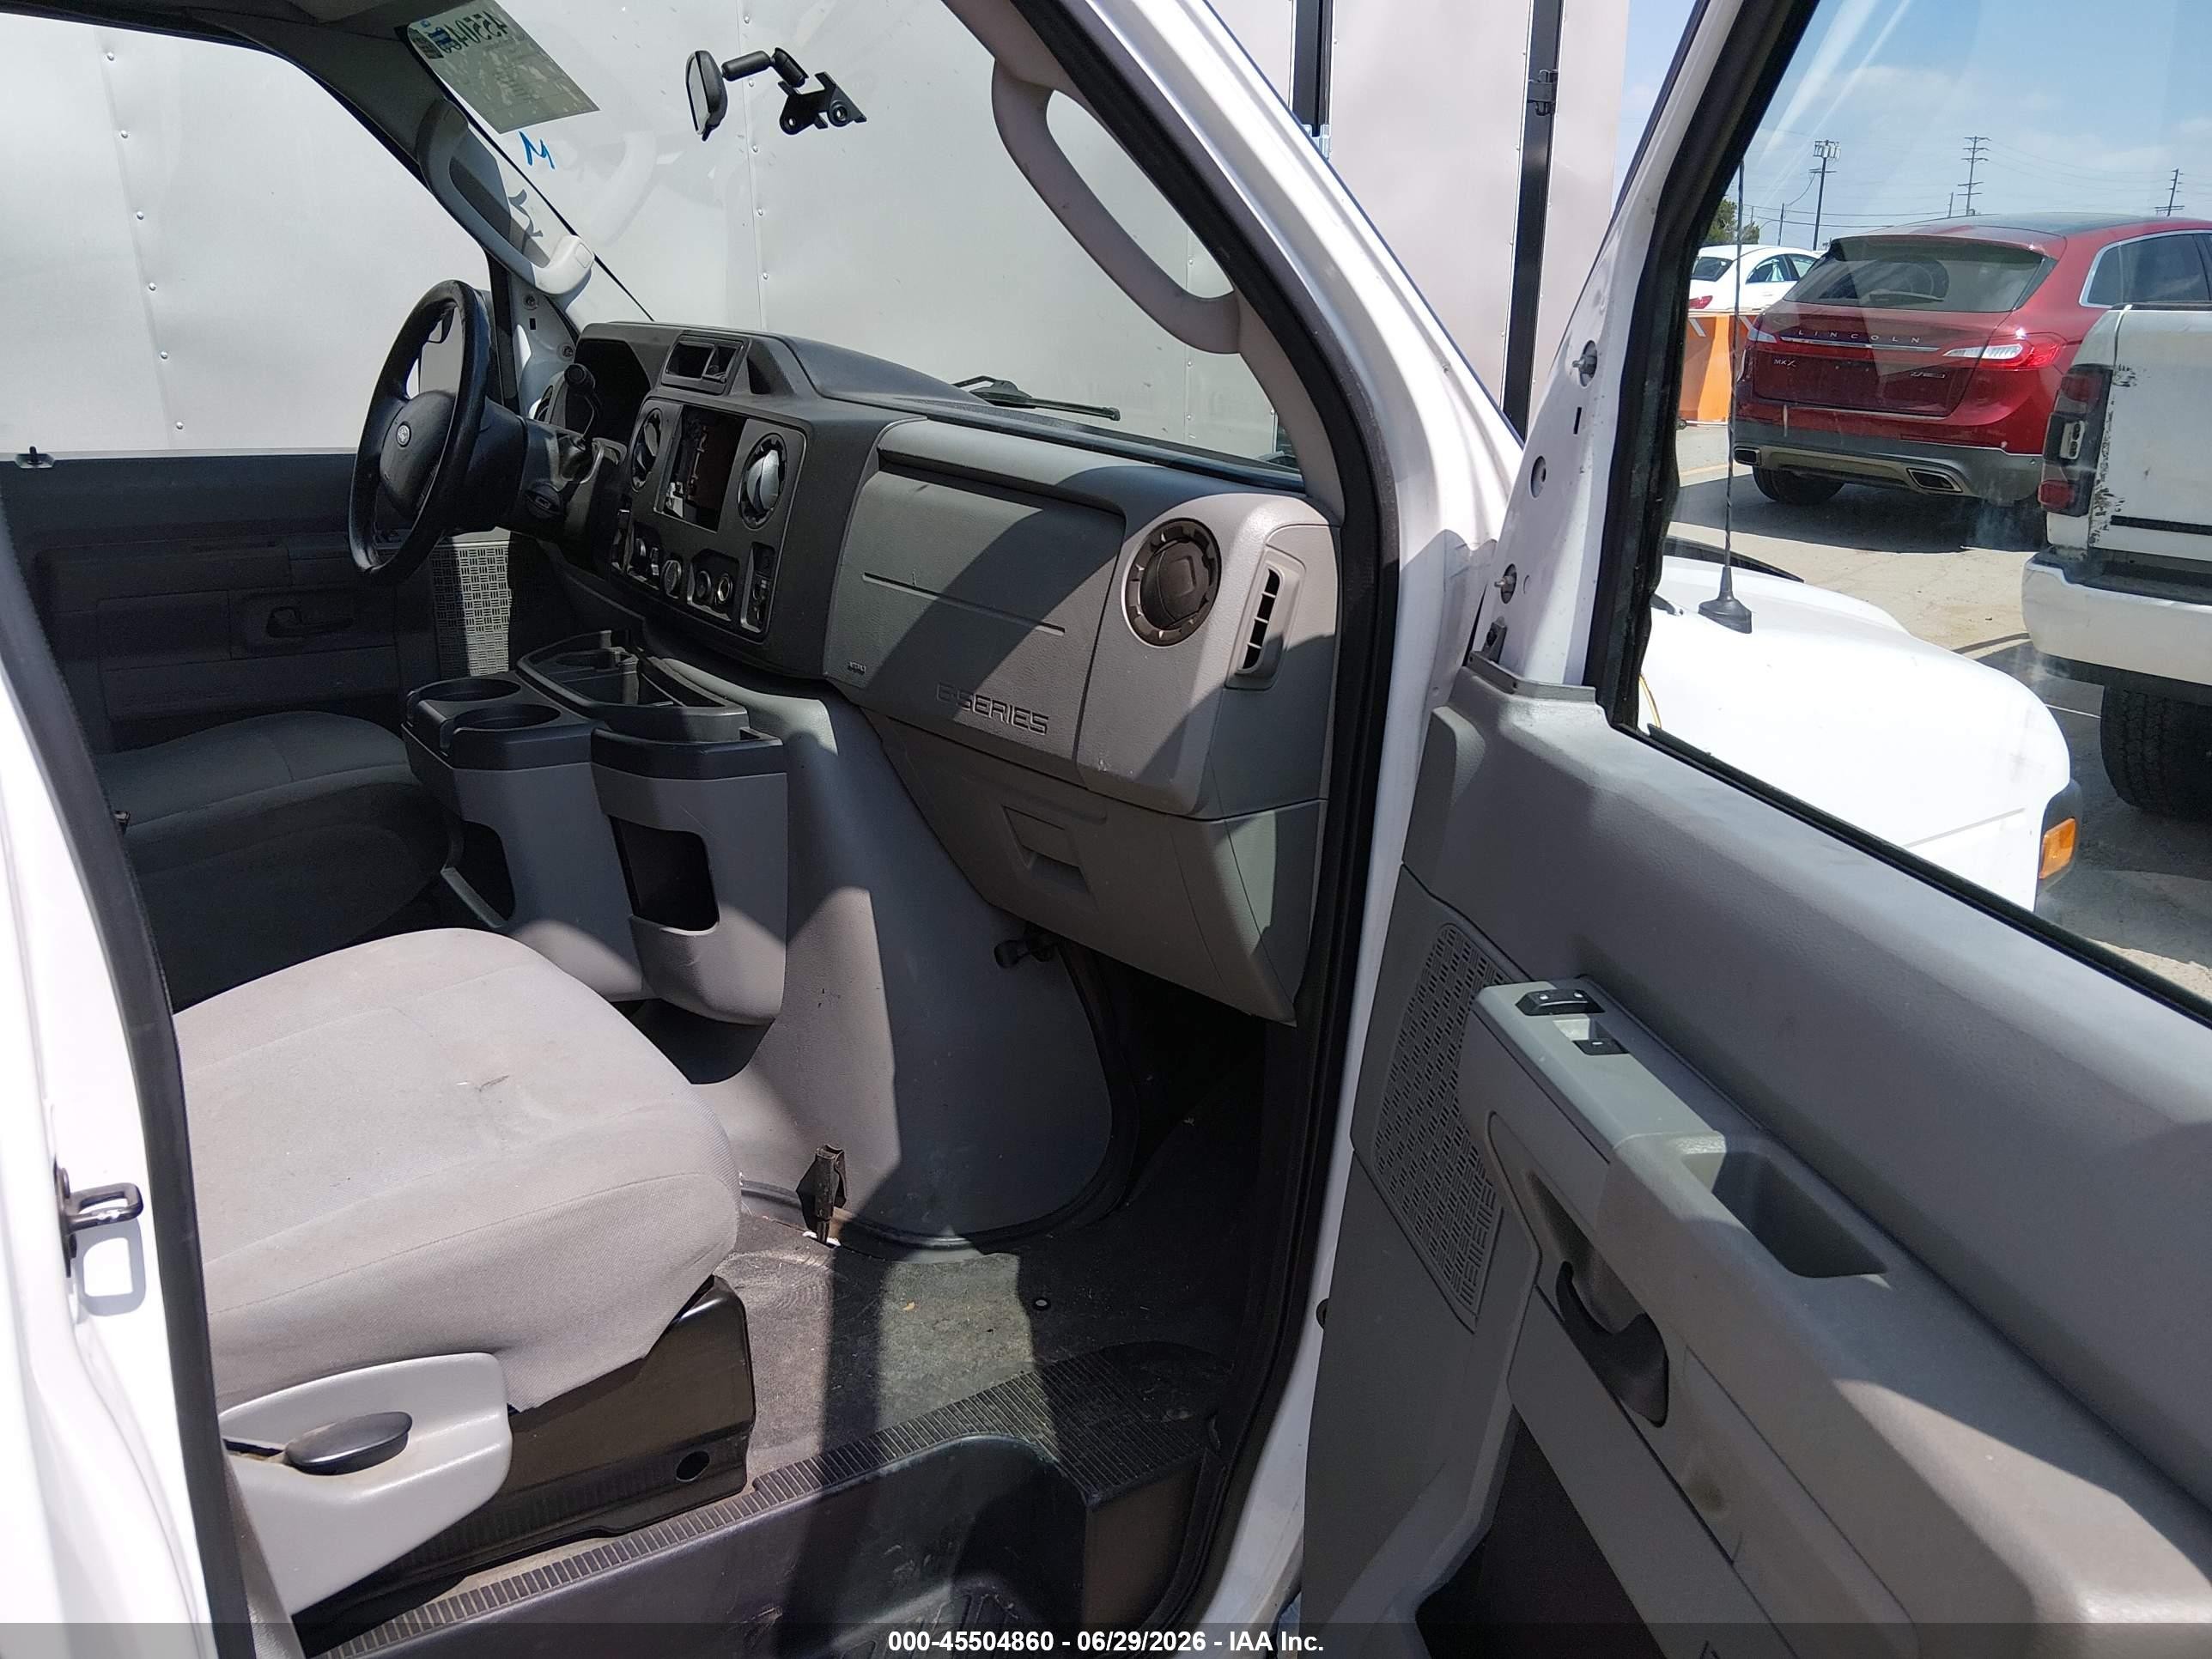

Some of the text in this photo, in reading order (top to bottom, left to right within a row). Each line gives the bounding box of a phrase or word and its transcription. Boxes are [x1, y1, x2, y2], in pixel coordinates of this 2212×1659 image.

[1798, 330, 1920, 343] LINCOLN
[1773, 359, 1796, 369] MKX
[935, 682, 1049, 736] E-SERIES
